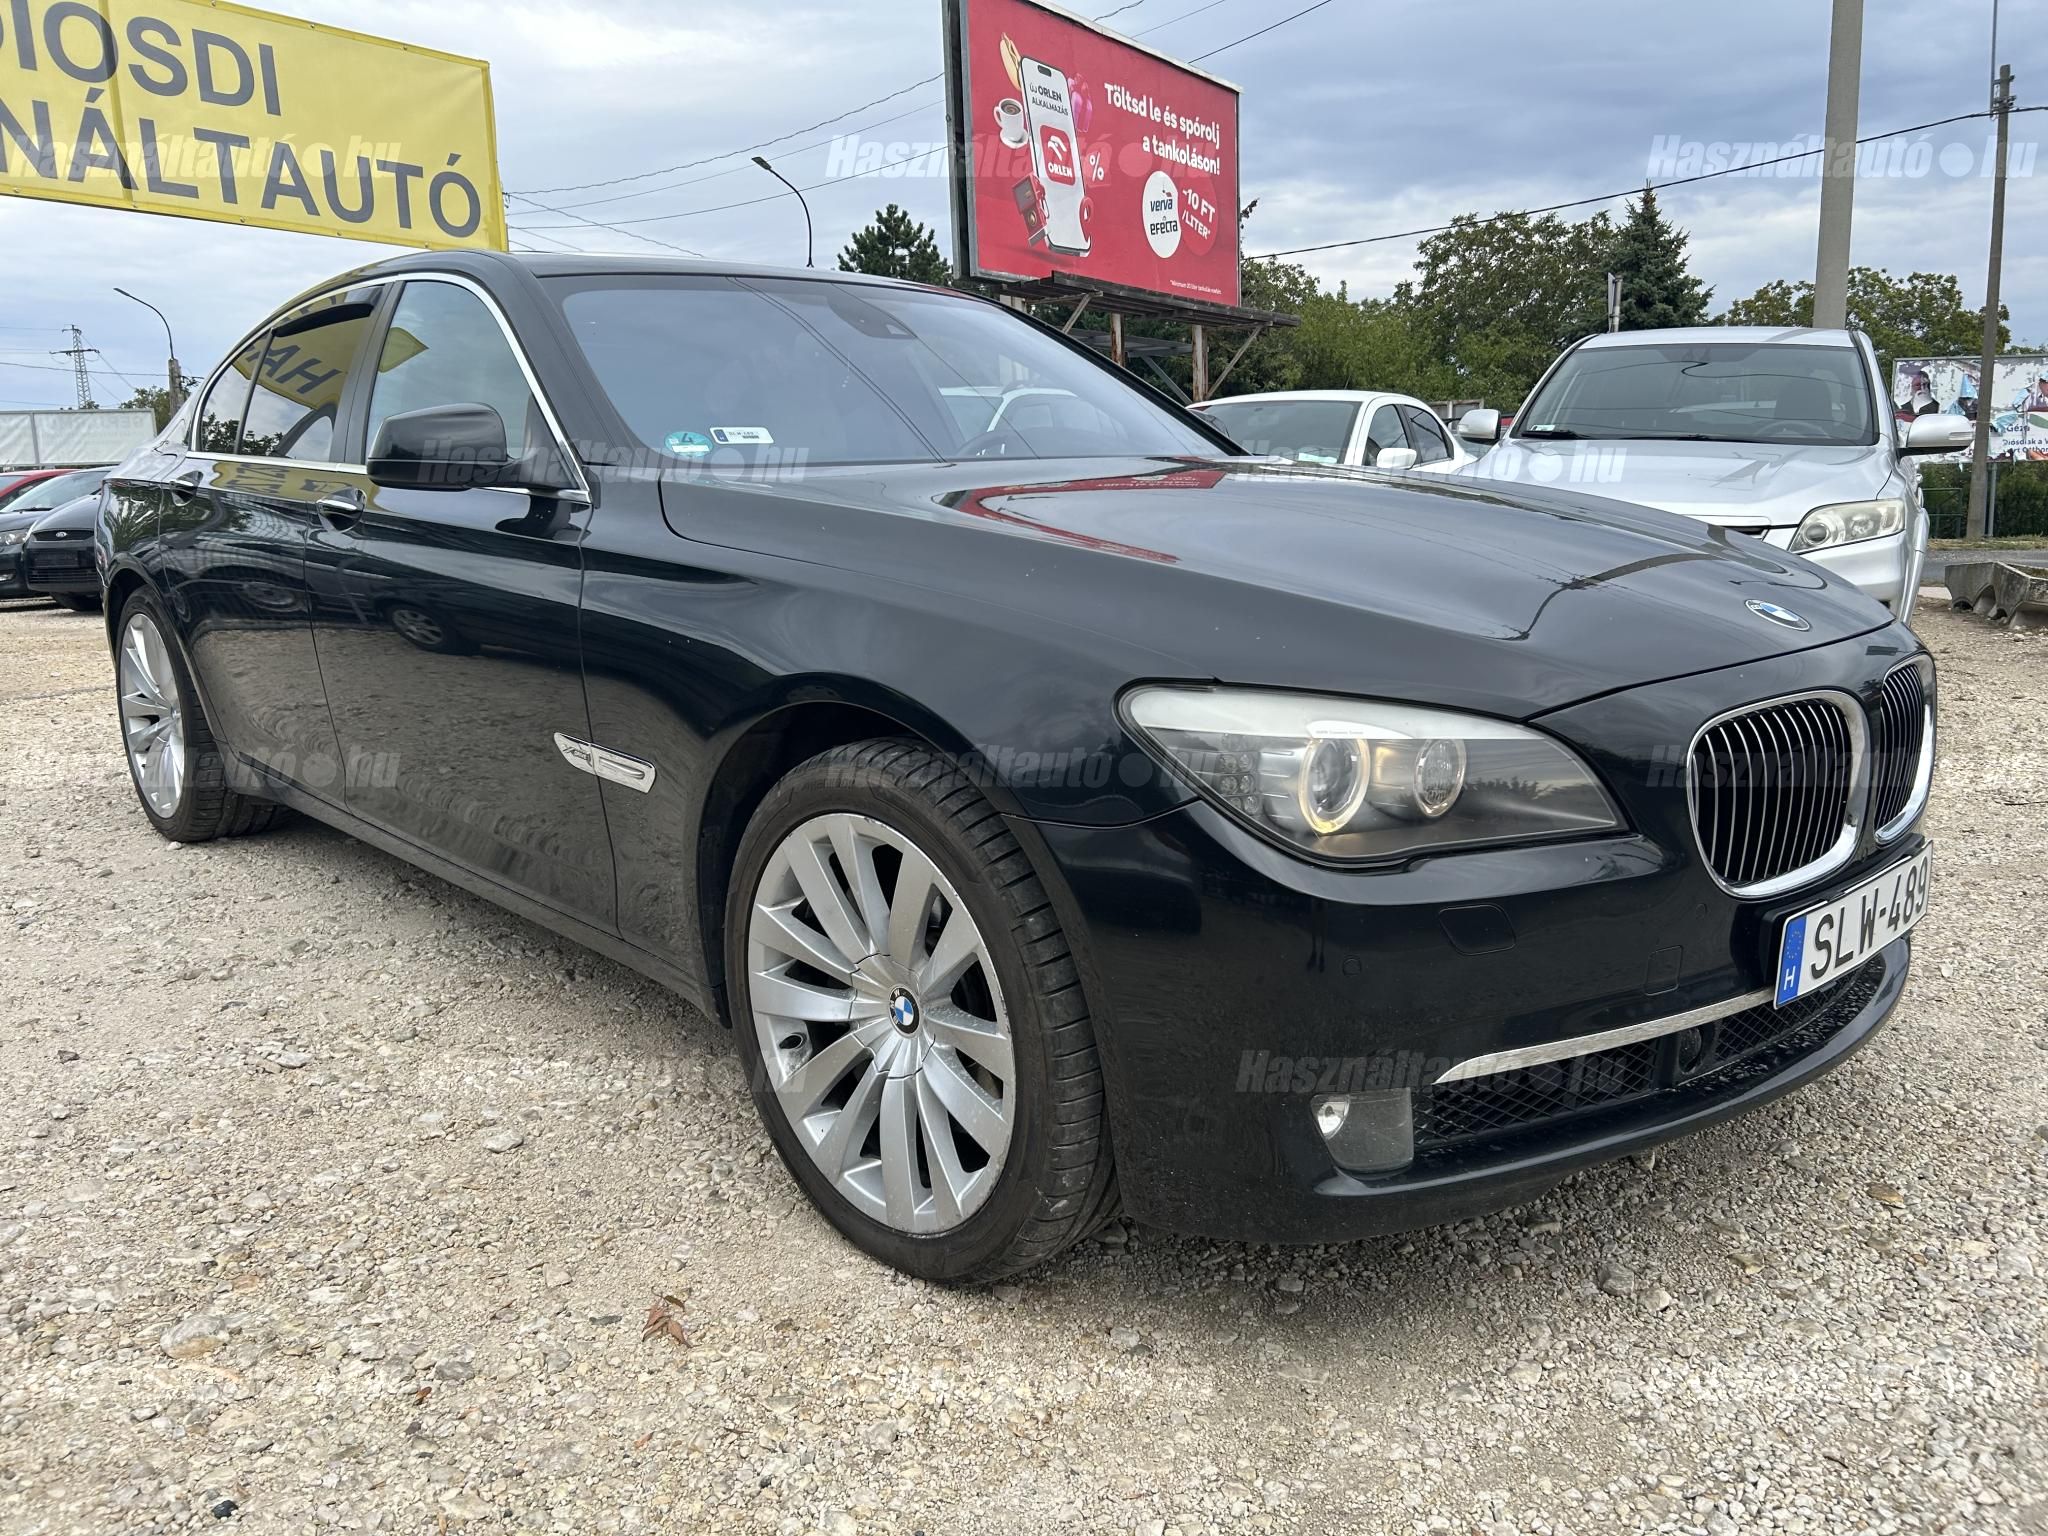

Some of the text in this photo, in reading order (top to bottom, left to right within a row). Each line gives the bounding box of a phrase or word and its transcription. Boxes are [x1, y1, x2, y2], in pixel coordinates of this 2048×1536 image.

[0, 0, 282, 117] IOSDI
[1032, 96, 1069, 116] ALKALMAZÁS
[1038, 85, 1062, 103] ORLEN
[1103, 82, 1219, 149] Töltsd le és spórolj
[1048, 162, 1073, 177] ORLEN
[1089, 152, 1104, 181] %
[1142, 134, 1220, 176] a tankoláson!
[1150, 198, 1173, 212] verva
[1182, 188, 1215, 223] -10 FT
[1811, 856, 1928, 979] SLW-489
[1783, 965, 1796, 991] H
